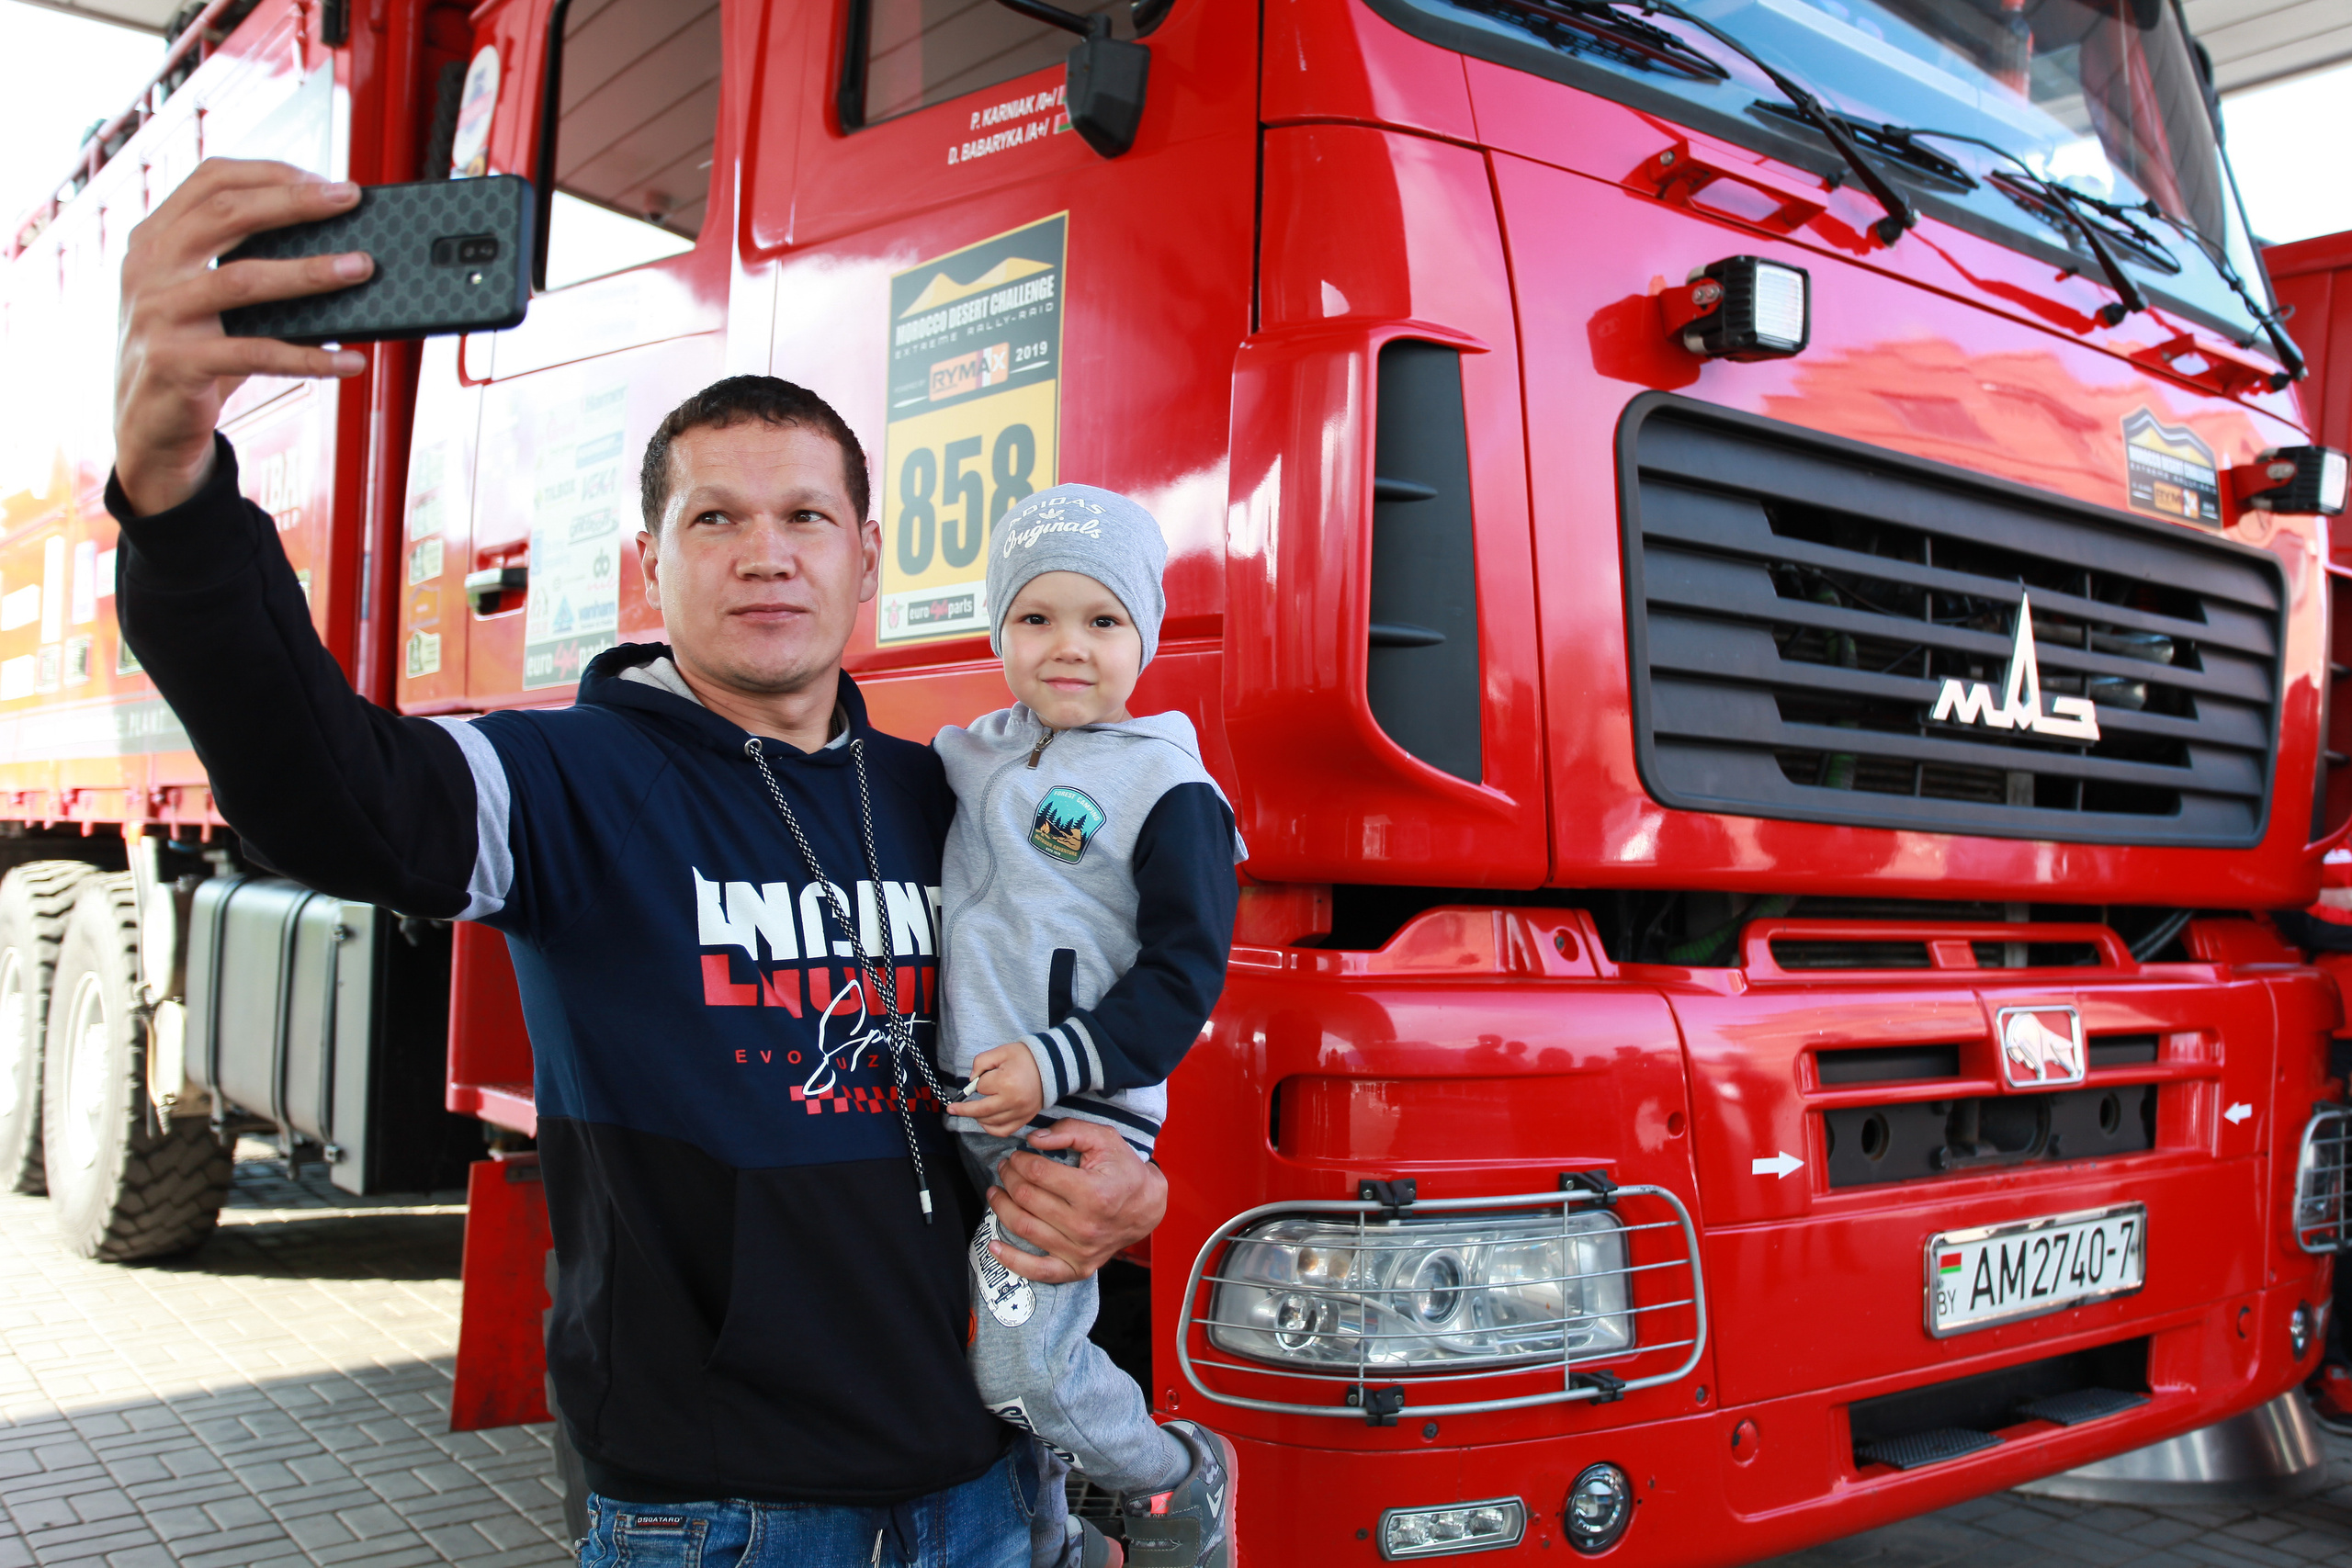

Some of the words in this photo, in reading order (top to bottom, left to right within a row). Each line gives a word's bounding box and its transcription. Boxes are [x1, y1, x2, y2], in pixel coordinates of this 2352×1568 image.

[970, 111, 981, 131] P.
[981, 94, 1036, 128] KARNIAK
[947, 146, 960, 165] D.
[960, 126, 1023, 162] BABARYKA
[895, 310, 948, 347] MOROCCO
[947, 296, 989, 330] DESERT
[989, 275, 1056, 317] CHALLENGE
[894, 331, 958, 360] EXTREME
[1015, 340, 1048, 363] 2019
[932, 349, 1007, 390] RYMAX
[897, 423, 1036, 577] 858
[1008, 496, 1107, 532] ADIDAS
[1003, 517, 1102, 559] Originals
[1053, 790, 1077, 800] FOREST
[1076, 796, 1101, 822] CAMPING
[1937, 1289, 1957, 1316] BY
